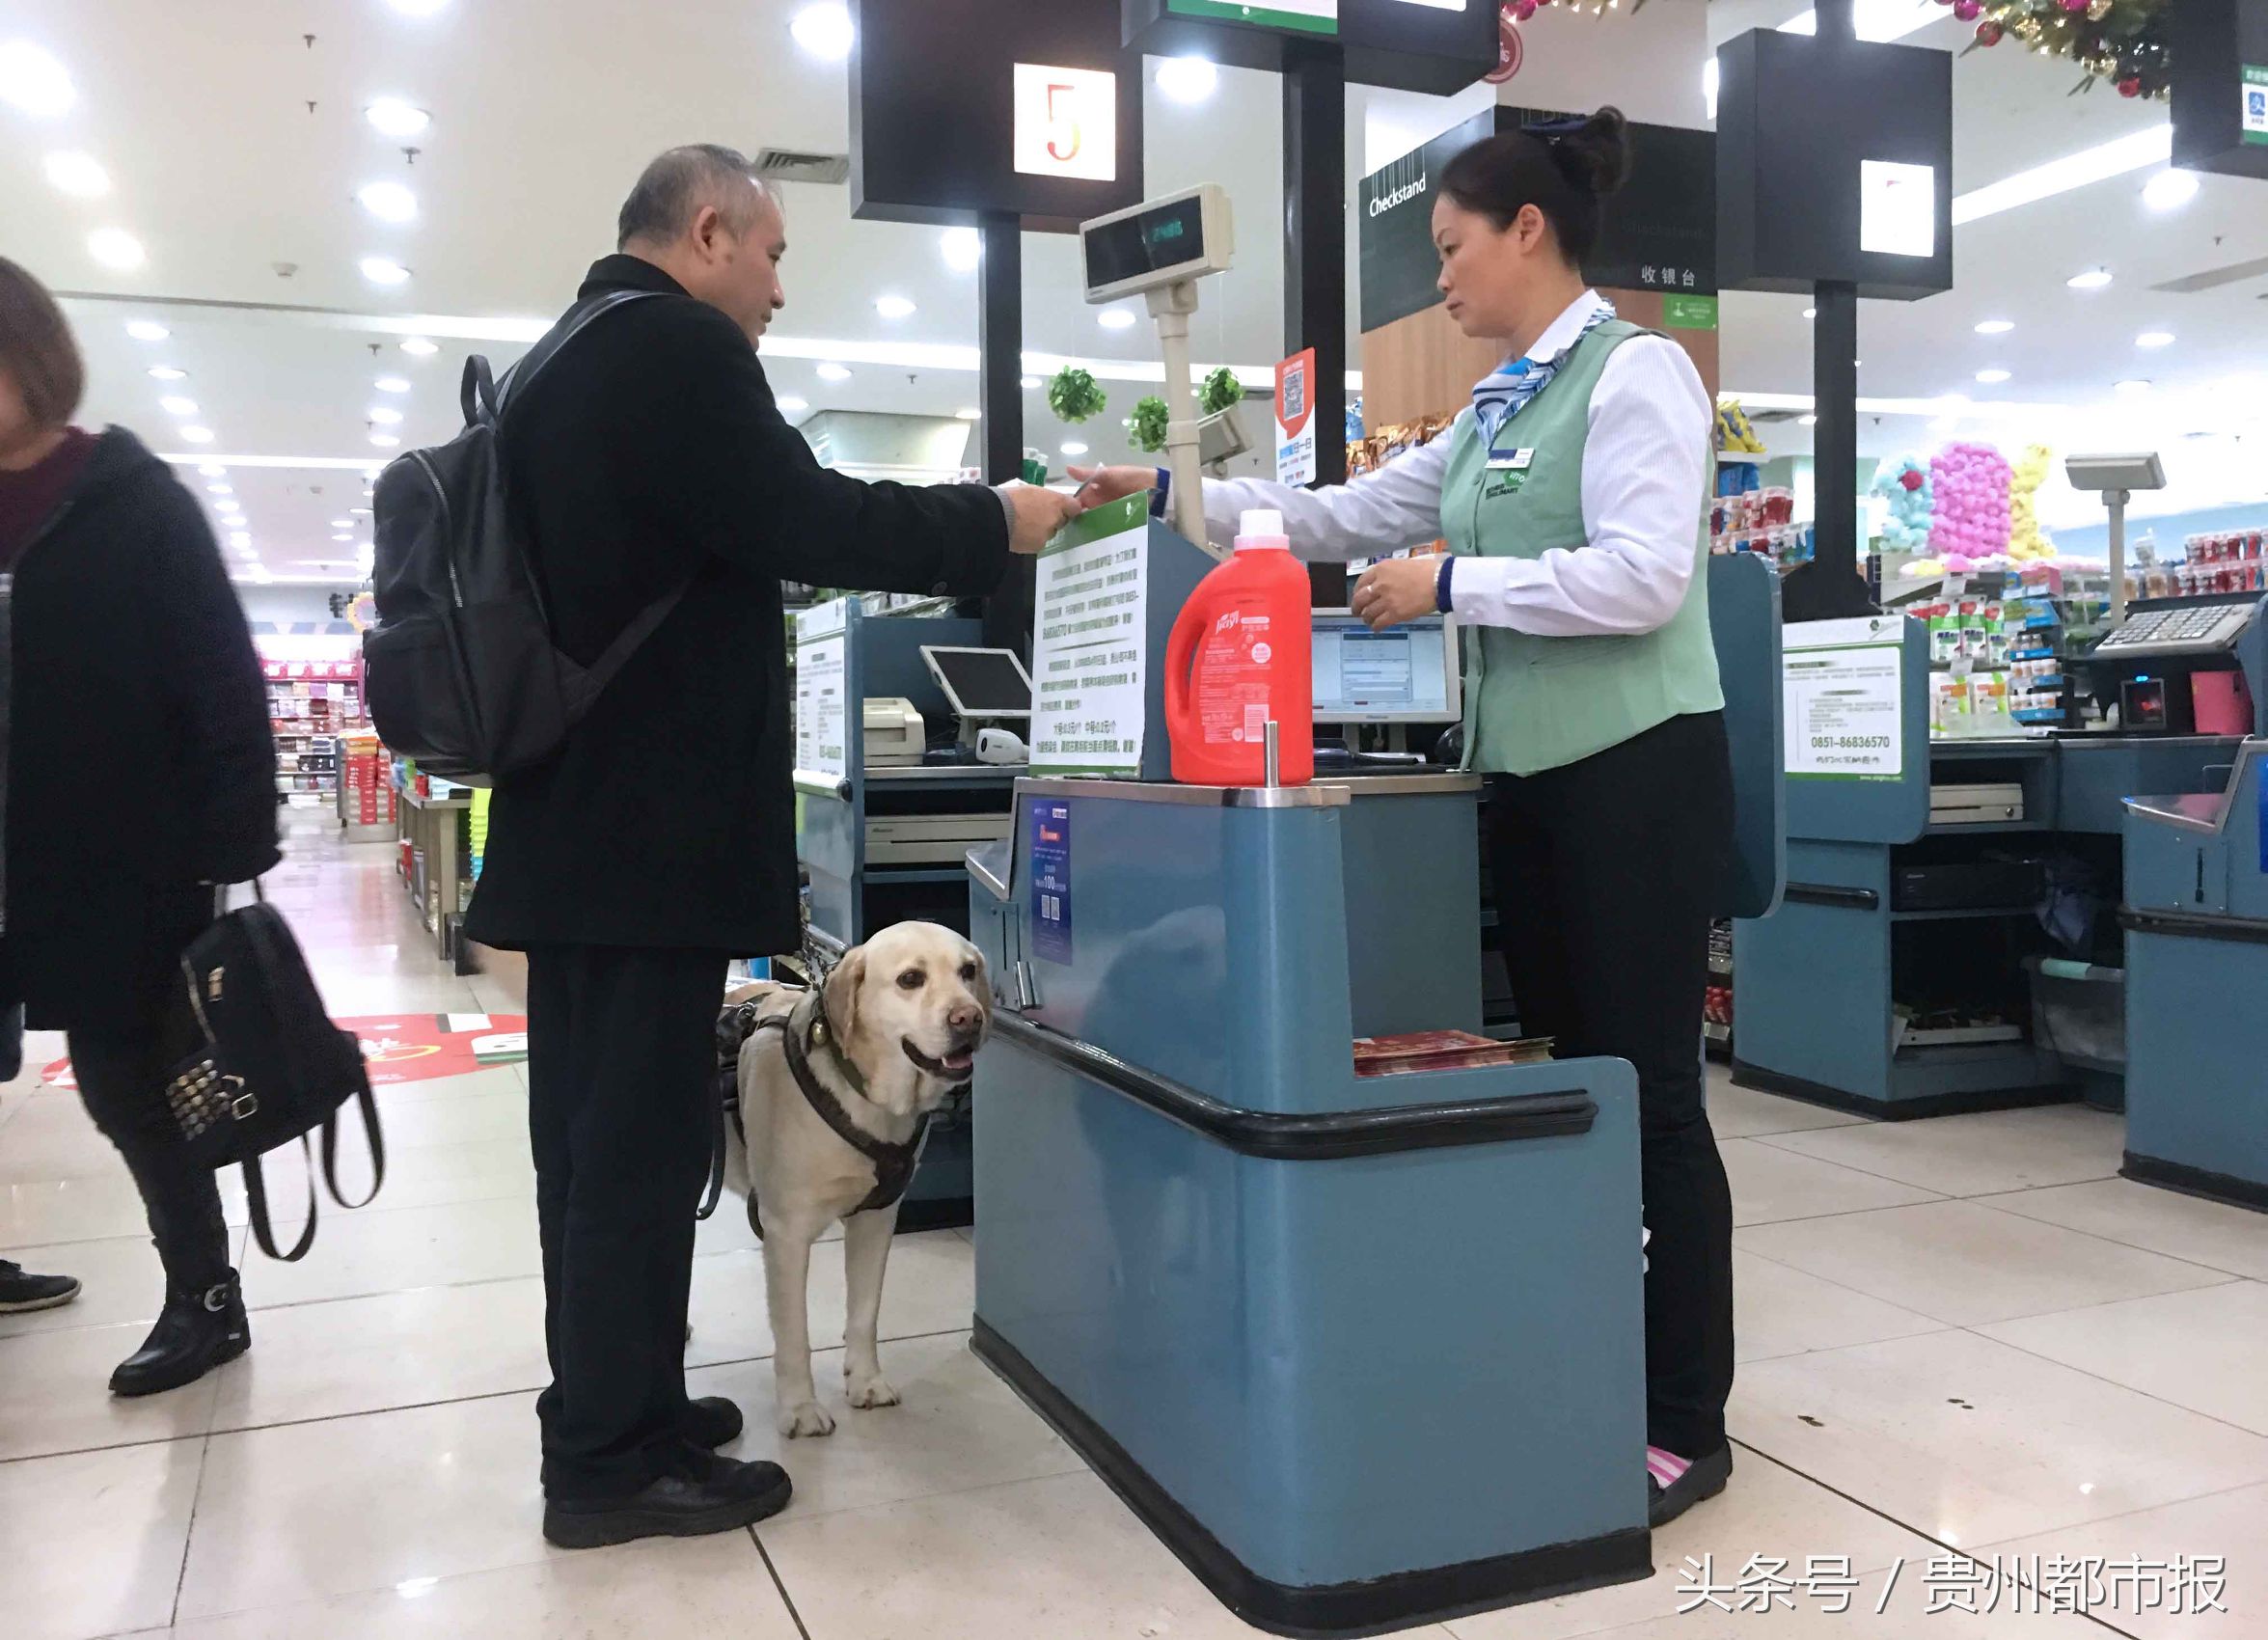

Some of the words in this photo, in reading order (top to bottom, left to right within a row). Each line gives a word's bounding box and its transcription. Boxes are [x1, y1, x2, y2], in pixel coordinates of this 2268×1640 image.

[1047, 84, 1080, 161] 5
[1369, 172, 1426, 217] Checkstand
[1641, 265, 1695, 287] 收银台
[1811, 736, 1890, 749] 0851-86836570
